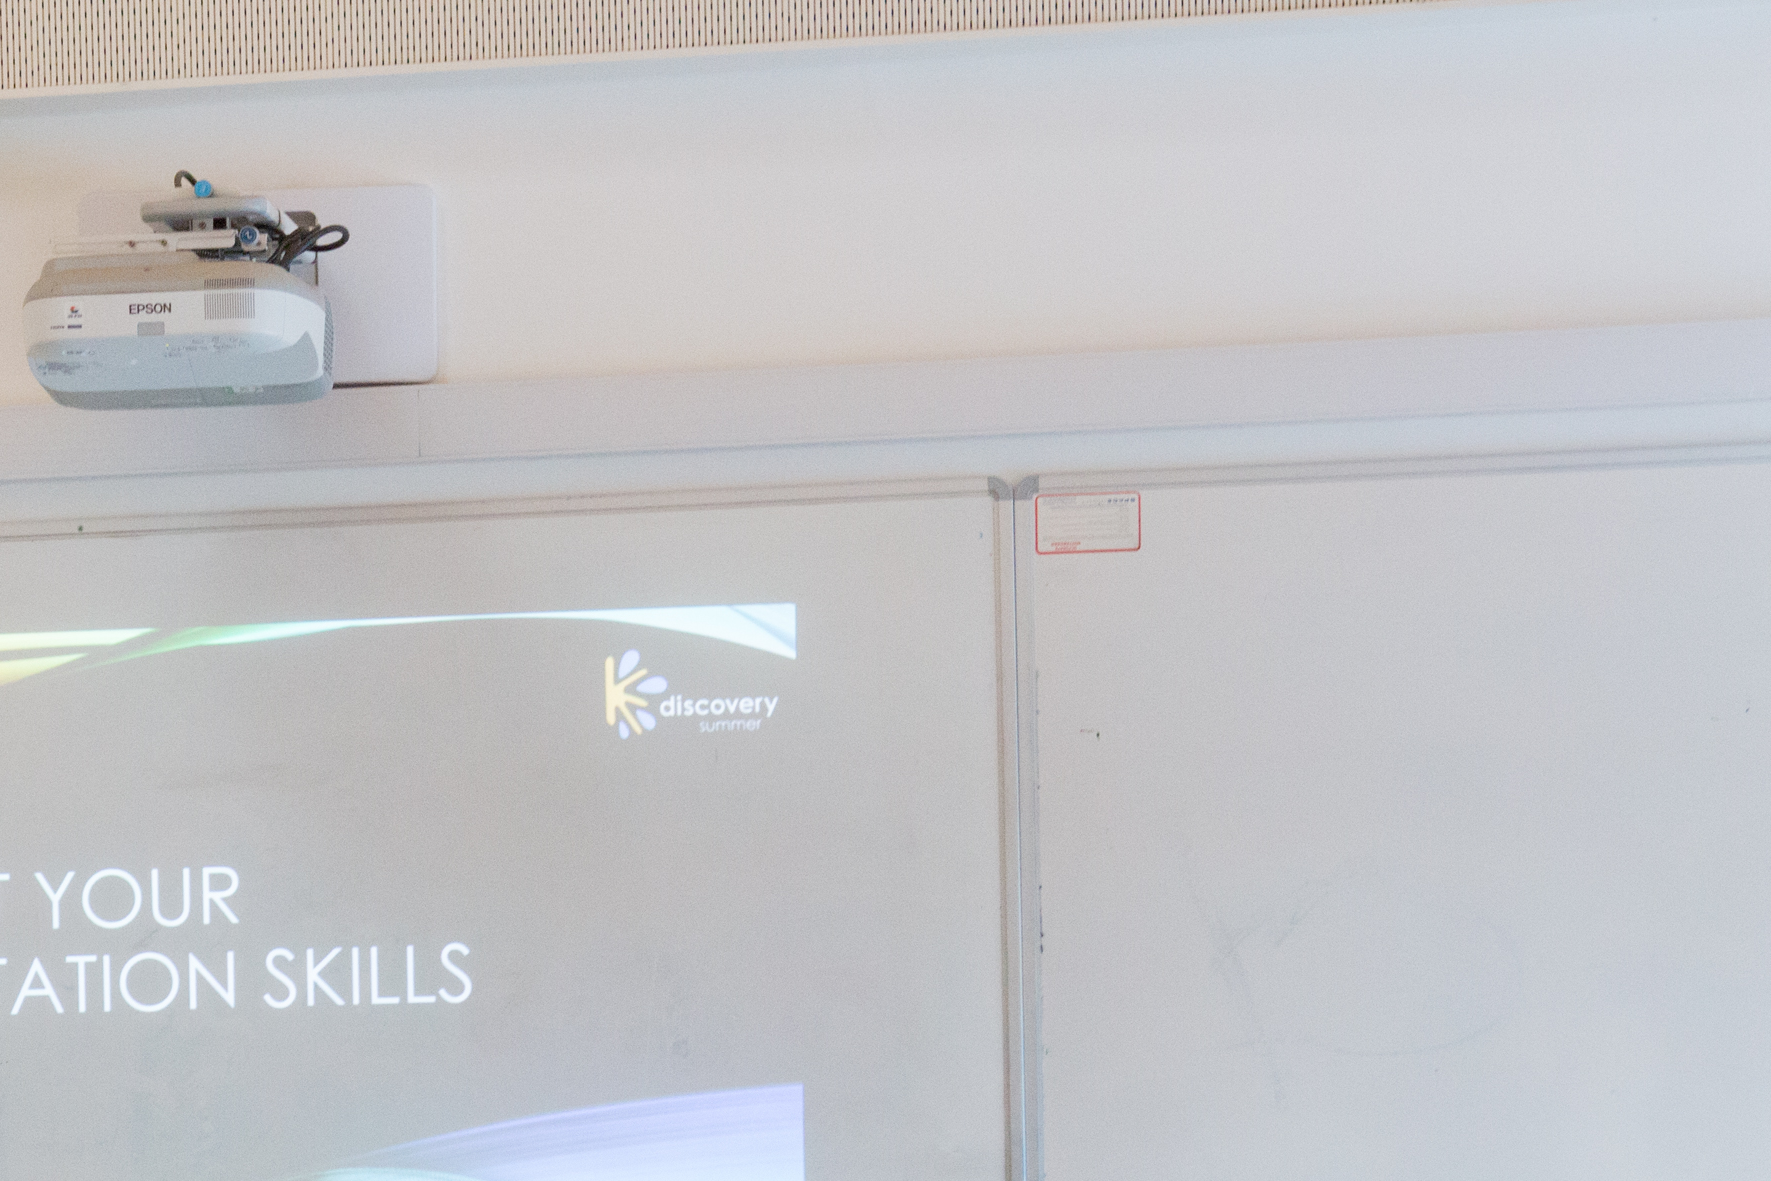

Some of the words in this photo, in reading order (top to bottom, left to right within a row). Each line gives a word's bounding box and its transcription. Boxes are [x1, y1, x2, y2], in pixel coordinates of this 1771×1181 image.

[128, 302, 172, 315] EPSON
[659, 694, 779, 718] discovery
[699, 718, 762, 733] summer
[33, 866, 240, 930] YOUR
[262, 942, 473, 1009] SKILLS
